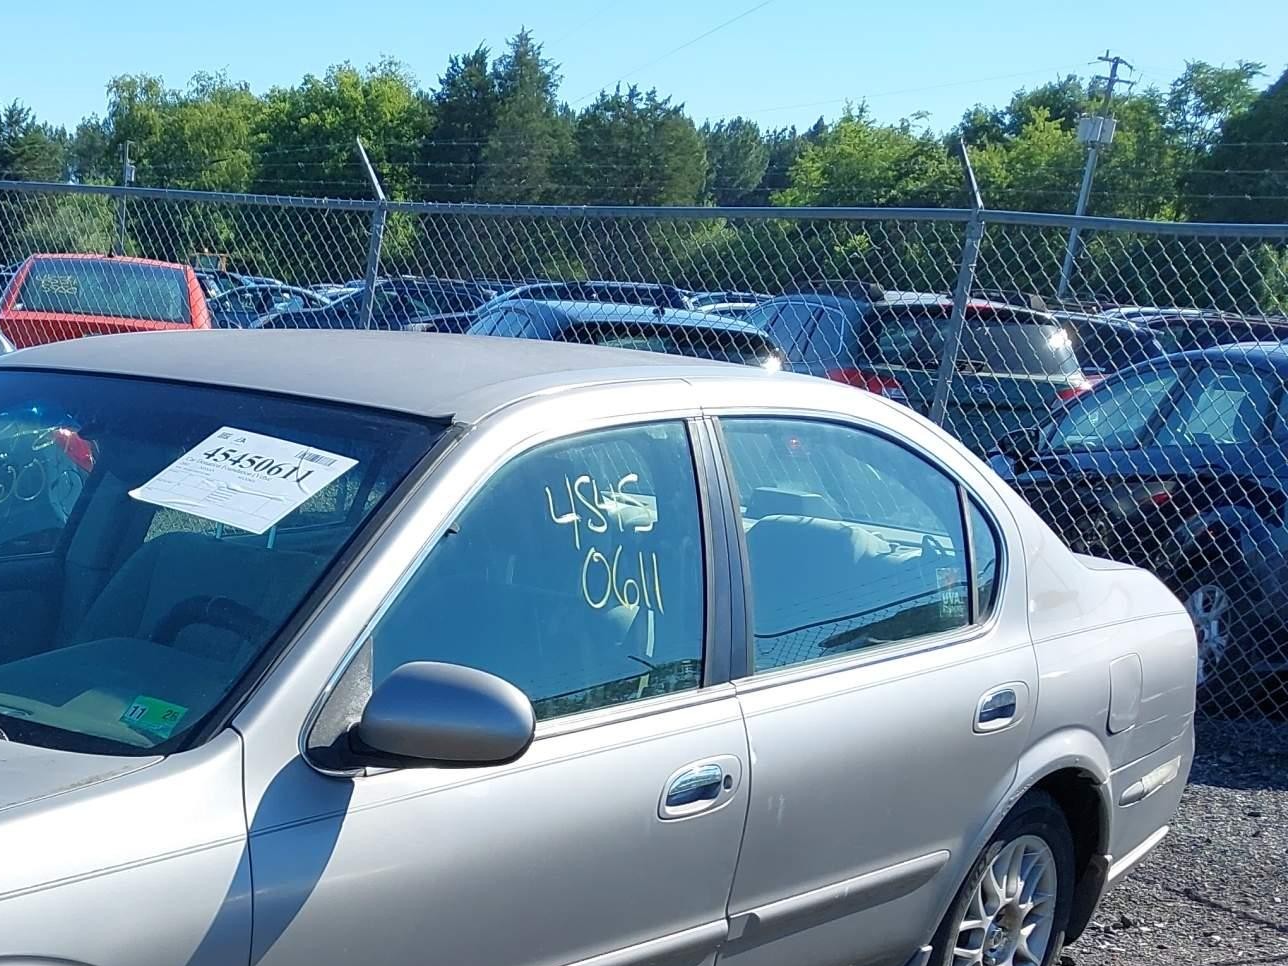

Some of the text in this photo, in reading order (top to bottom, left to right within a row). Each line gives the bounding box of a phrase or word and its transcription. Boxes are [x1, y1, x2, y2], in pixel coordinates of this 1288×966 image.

[203, 446, 315, 482] 45450611
[544, 472, 655, 550] 4545
[582, 545, 665, 615] 0611
[129, 705, 146, 720] 11
